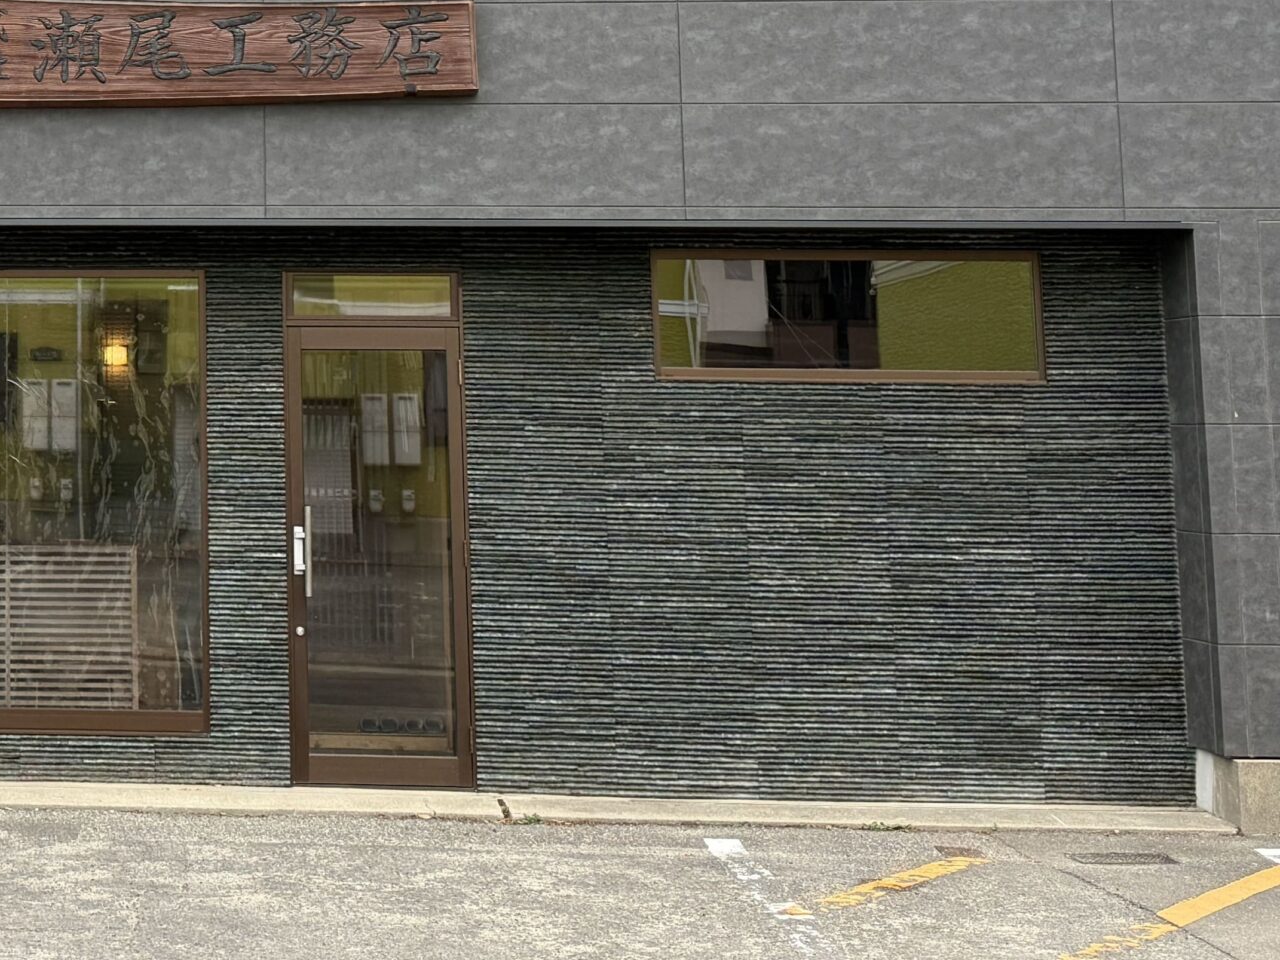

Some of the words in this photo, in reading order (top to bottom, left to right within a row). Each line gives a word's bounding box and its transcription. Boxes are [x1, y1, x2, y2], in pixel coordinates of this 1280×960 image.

[31, 7, 450, 84] 瀬尾工務店
